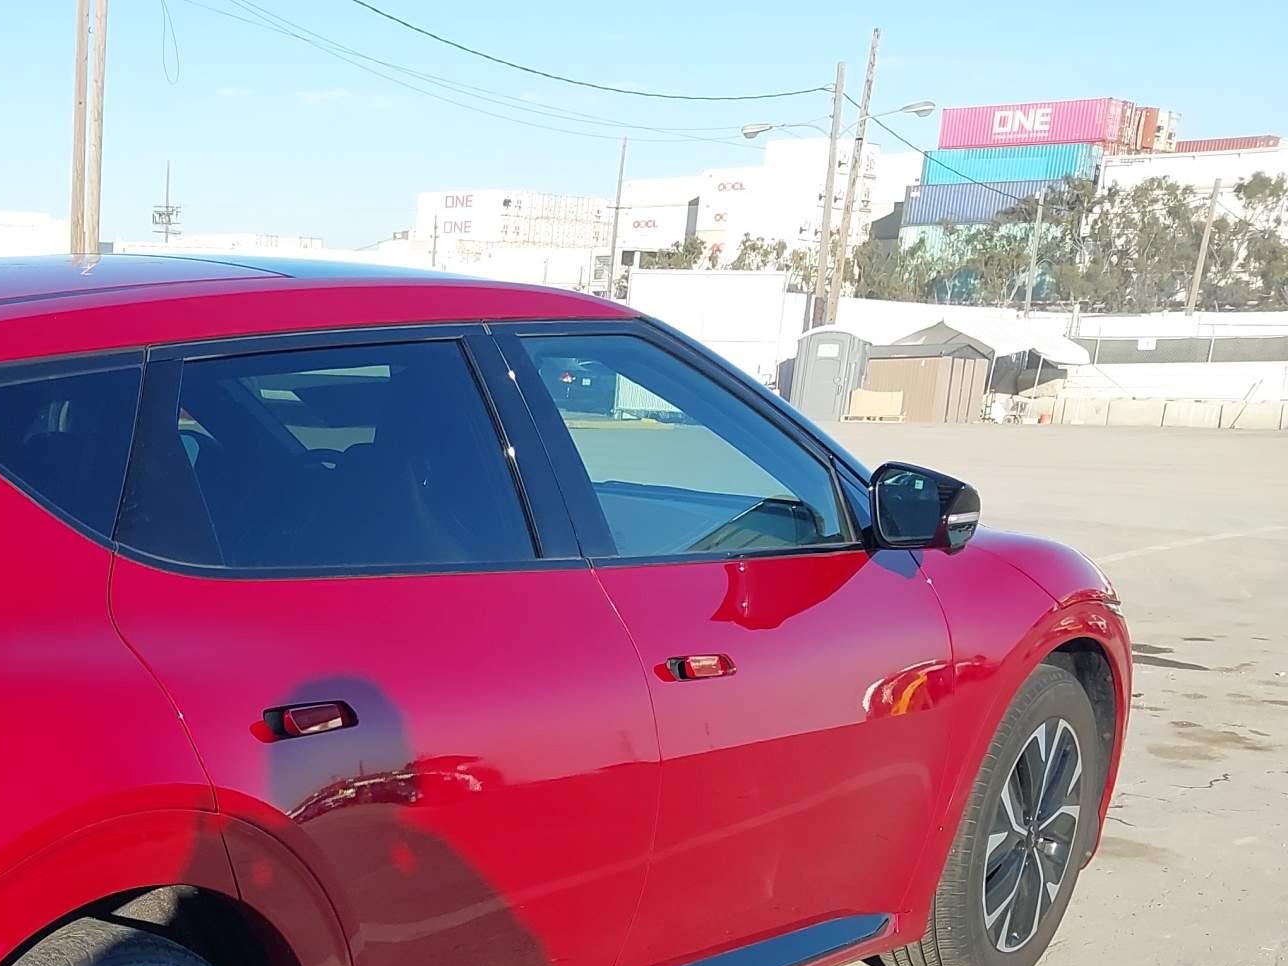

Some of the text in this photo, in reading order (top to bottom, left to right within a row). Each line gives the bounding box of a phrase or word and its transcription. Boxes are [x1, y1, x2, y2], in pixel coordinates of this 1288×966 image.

[992, 107, 1052, 133] ONE
[717, 181, 746, 192] OOCL
[444, 194, 473, 209] ONE
[443, 220, 472, 234] ONE
